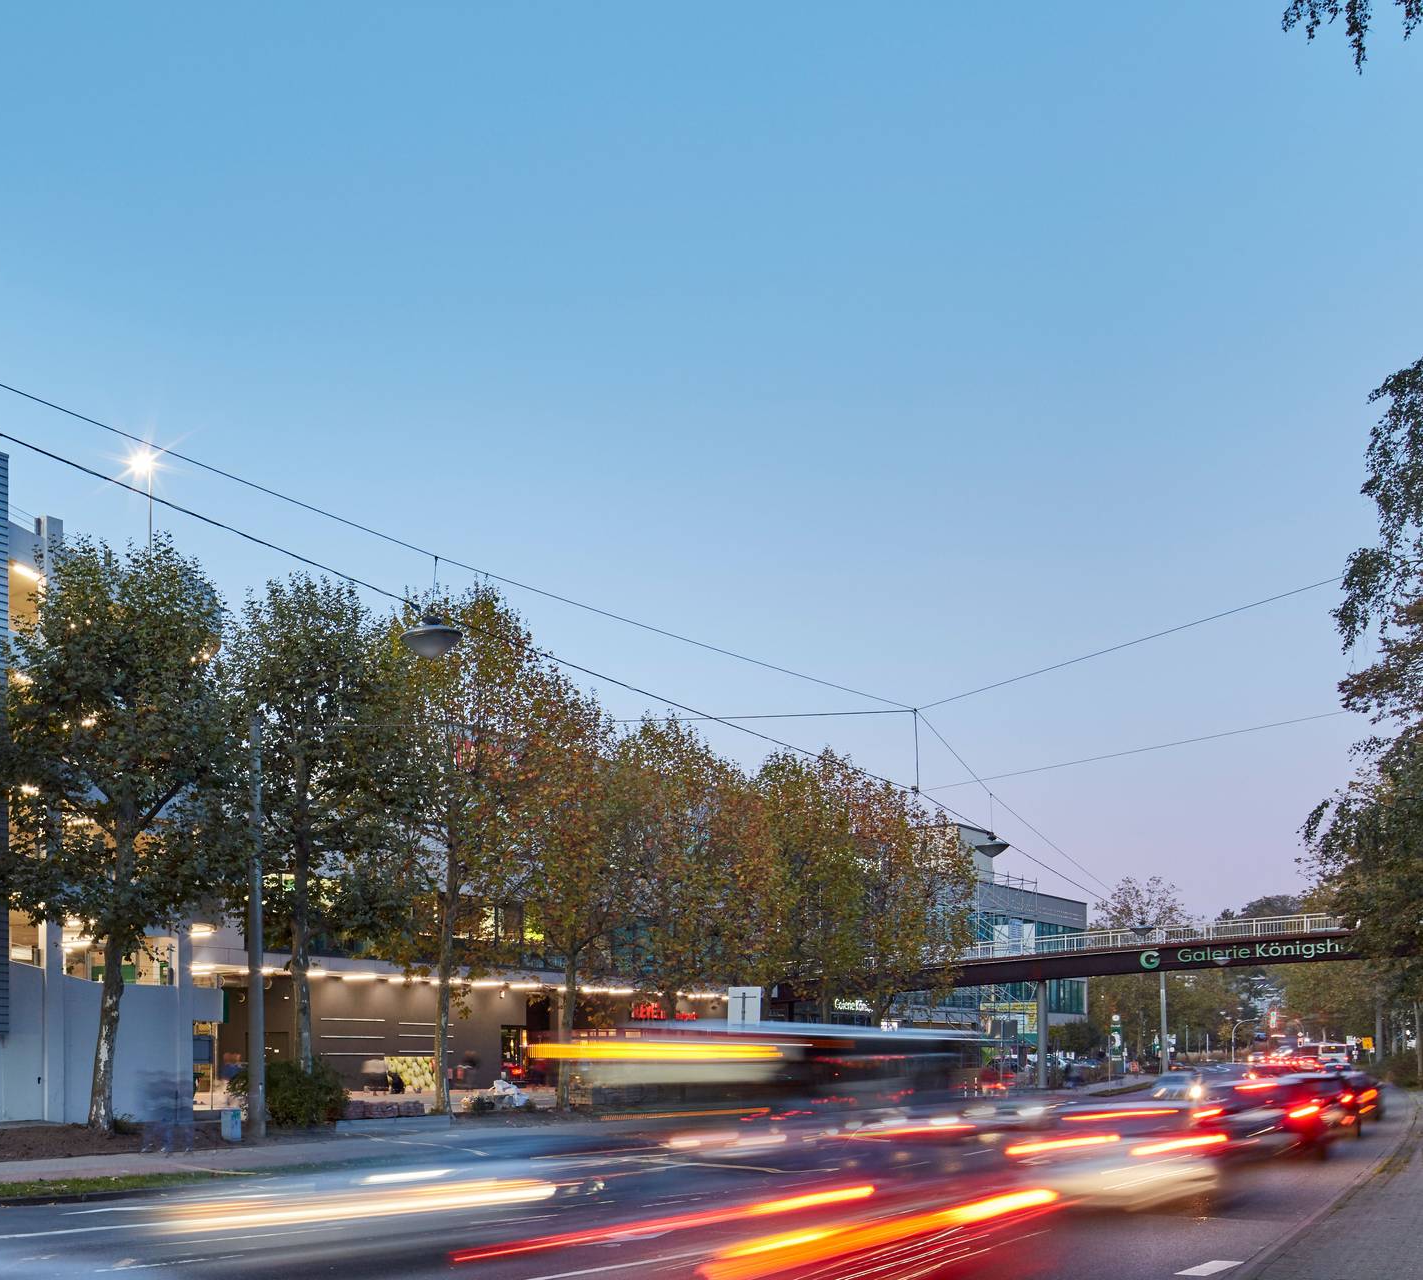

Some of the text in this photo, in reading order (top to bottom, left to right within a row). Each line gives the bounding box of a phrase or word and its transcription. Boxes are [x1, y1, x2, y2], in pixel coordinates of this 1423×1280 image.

[1139, 950, 1161, 970] G
[1177, 938, 1345, 963] Galerie Königsh
